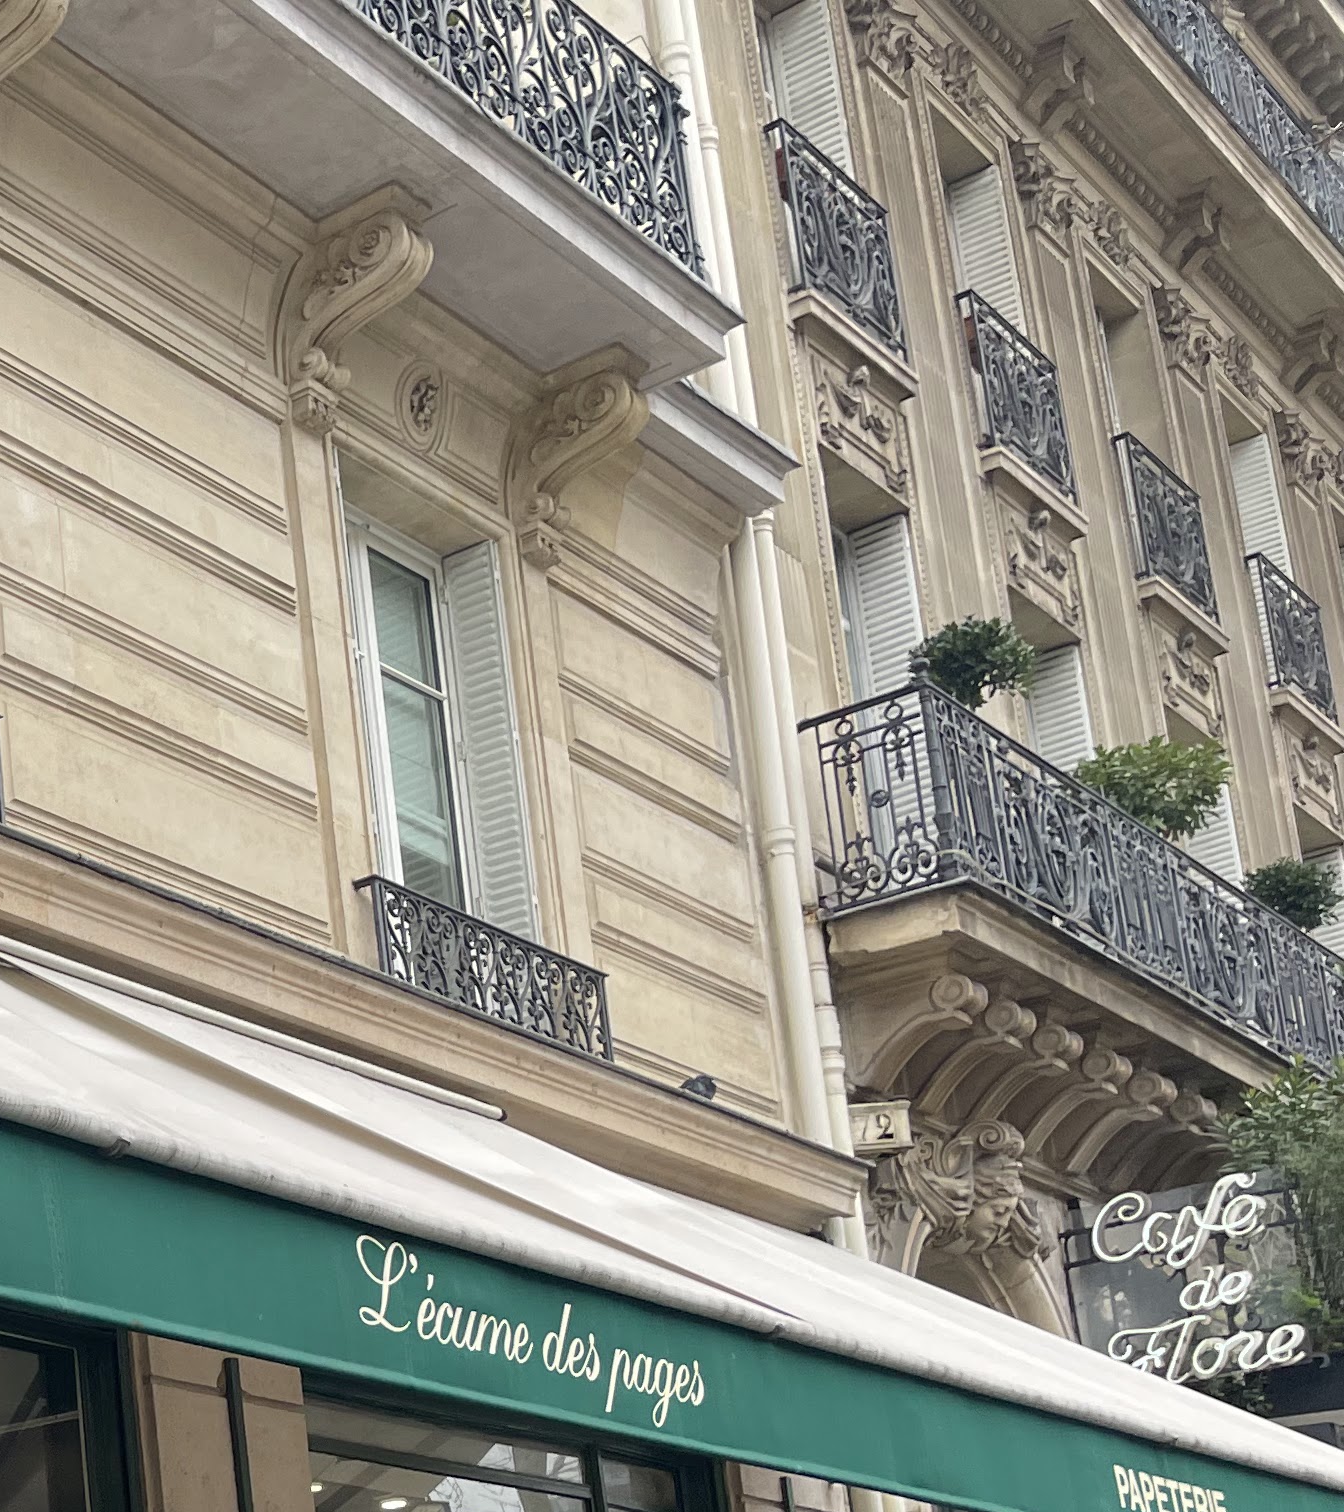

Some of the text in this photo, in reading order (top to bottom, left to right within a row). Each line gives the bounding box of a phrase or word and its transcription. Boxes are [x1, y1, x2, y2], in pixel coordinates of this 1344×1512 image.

[1180, 1264, 1253, 1312] de
[356, 1234, 705, 1428] L'écume des pages
[1108, 1314, 1309, 1385] Flore
